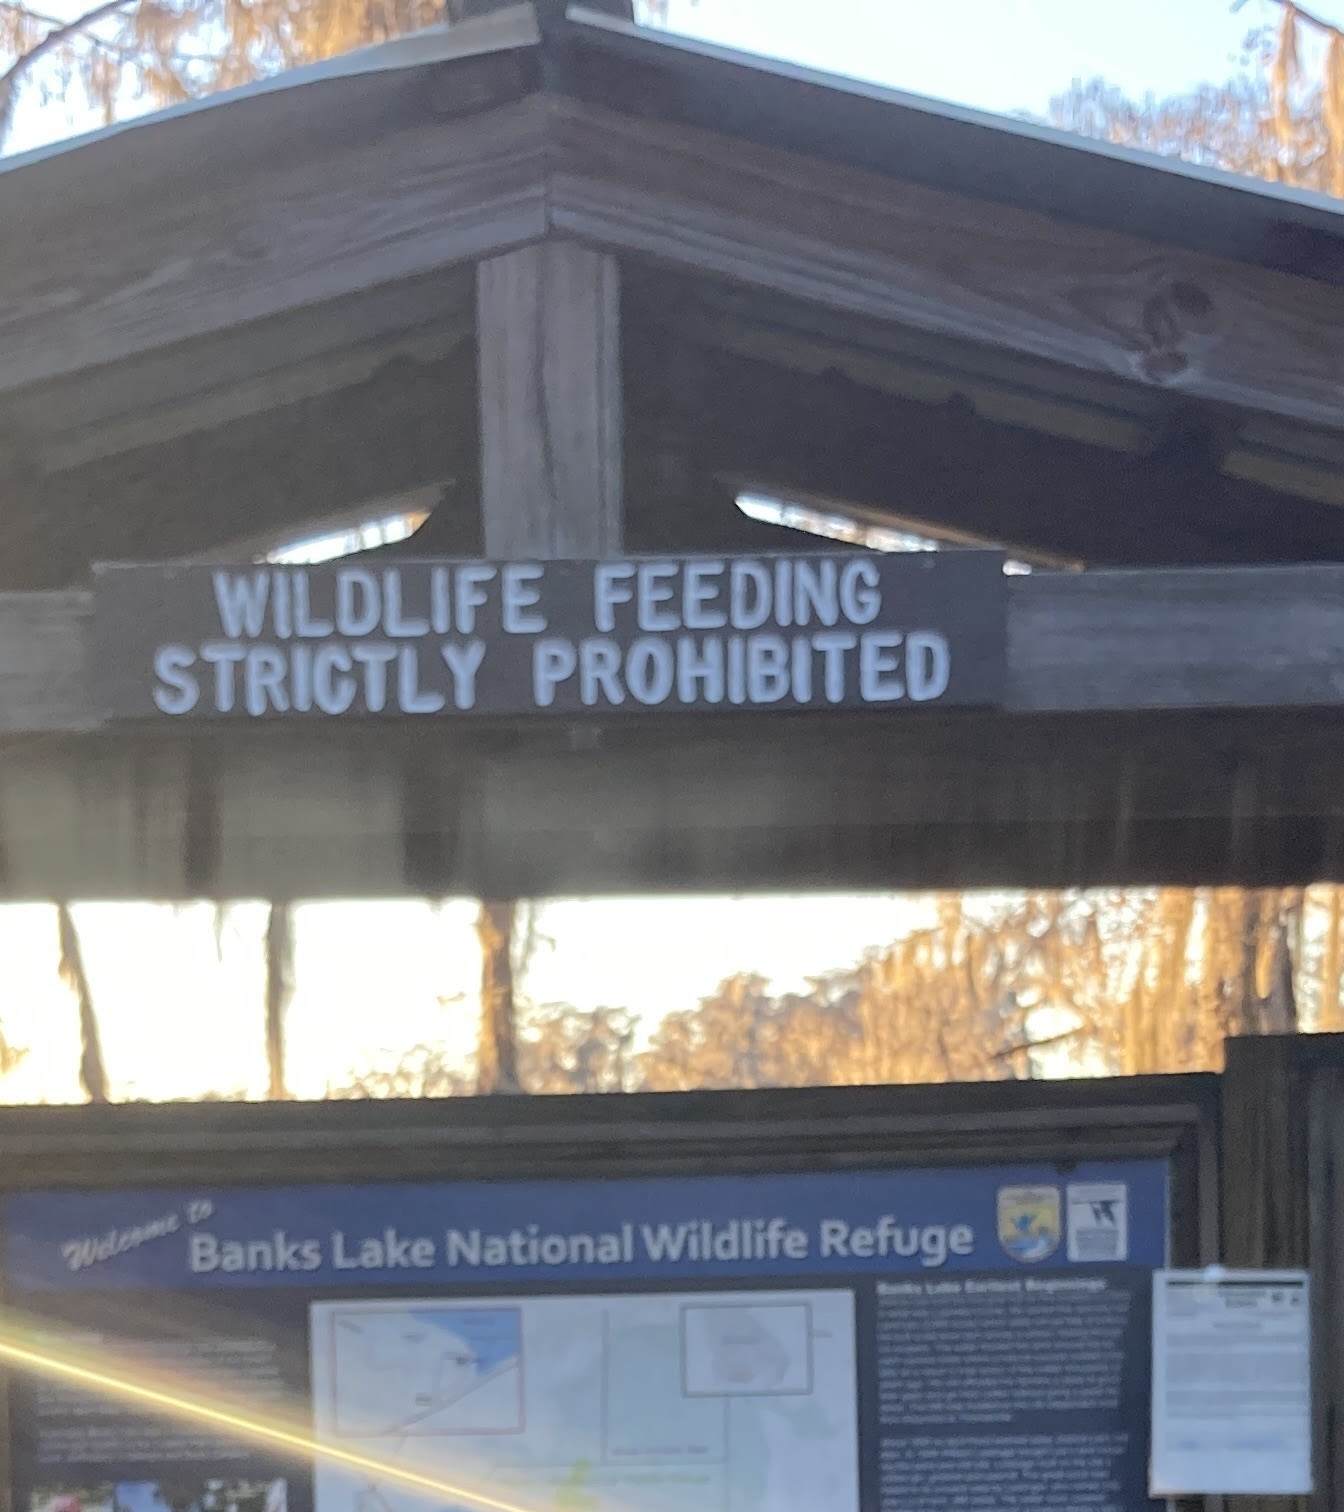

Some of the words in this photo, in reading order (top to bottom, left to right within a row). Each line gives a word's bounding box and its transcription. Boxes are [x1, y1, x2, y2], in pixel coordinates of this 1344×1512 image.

[214, 562, 549, 639] WILDLIFE
[594, 558, 882, 634] FEEDING
[152, 637, 487, 716] STRICTLY
[532, 631, 951, 709] PROHIBITED
[60, 1212, 181, 1271] Welcome
[189, 1229, 322, 1275] Banks
[331, 1227, 437, 1271] Lake
[445, 1222, 634, 1269] National
[643, 1217, 810, 1264] Wildlife
[819, 1215, 975, 1268] Refuge
